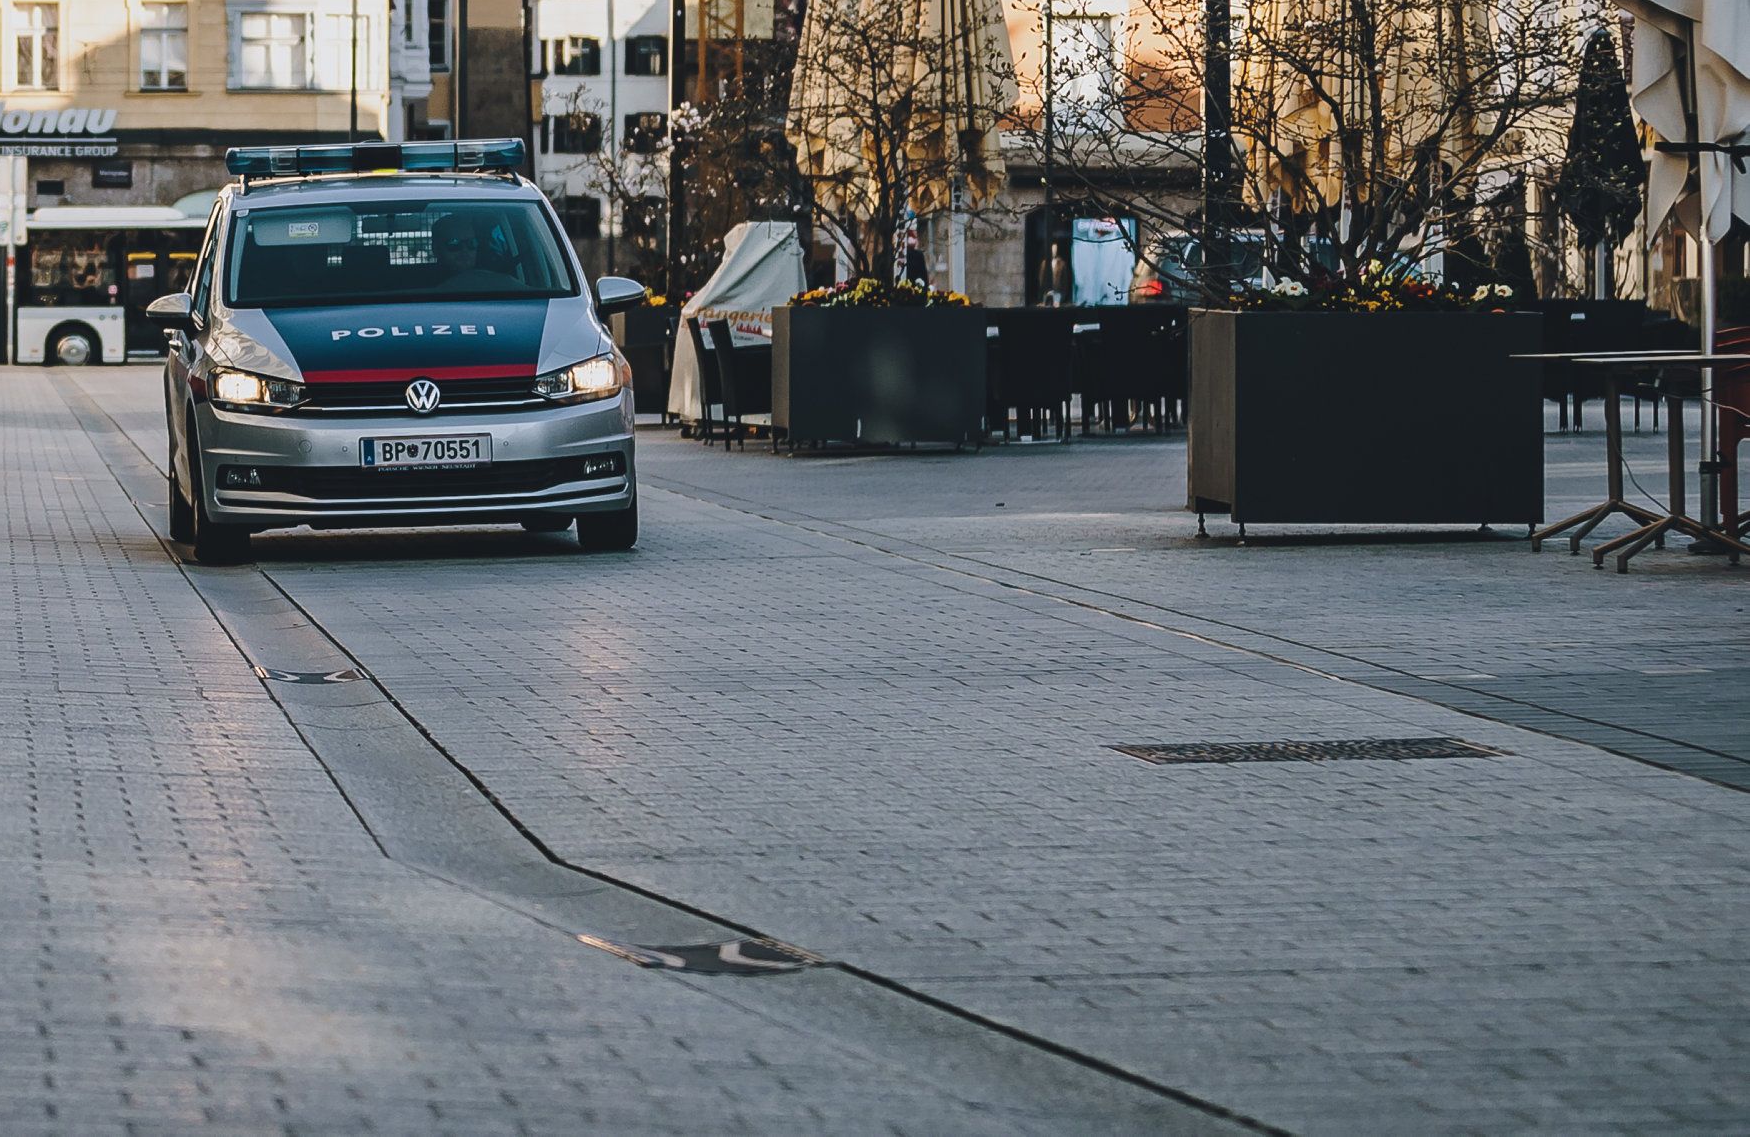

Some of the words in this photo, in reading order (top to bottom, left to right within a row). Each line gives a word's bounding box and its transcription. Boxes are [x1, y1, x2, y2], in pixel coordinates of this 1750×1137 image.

[1, 145, 72, 157] INSURANCE
[75, 145, 119, 157] GROUP
[331, 324, 496, 341] POLIZEI
[381, 442, 406, 462] BP
[421, 439, 480, 461] 70551
